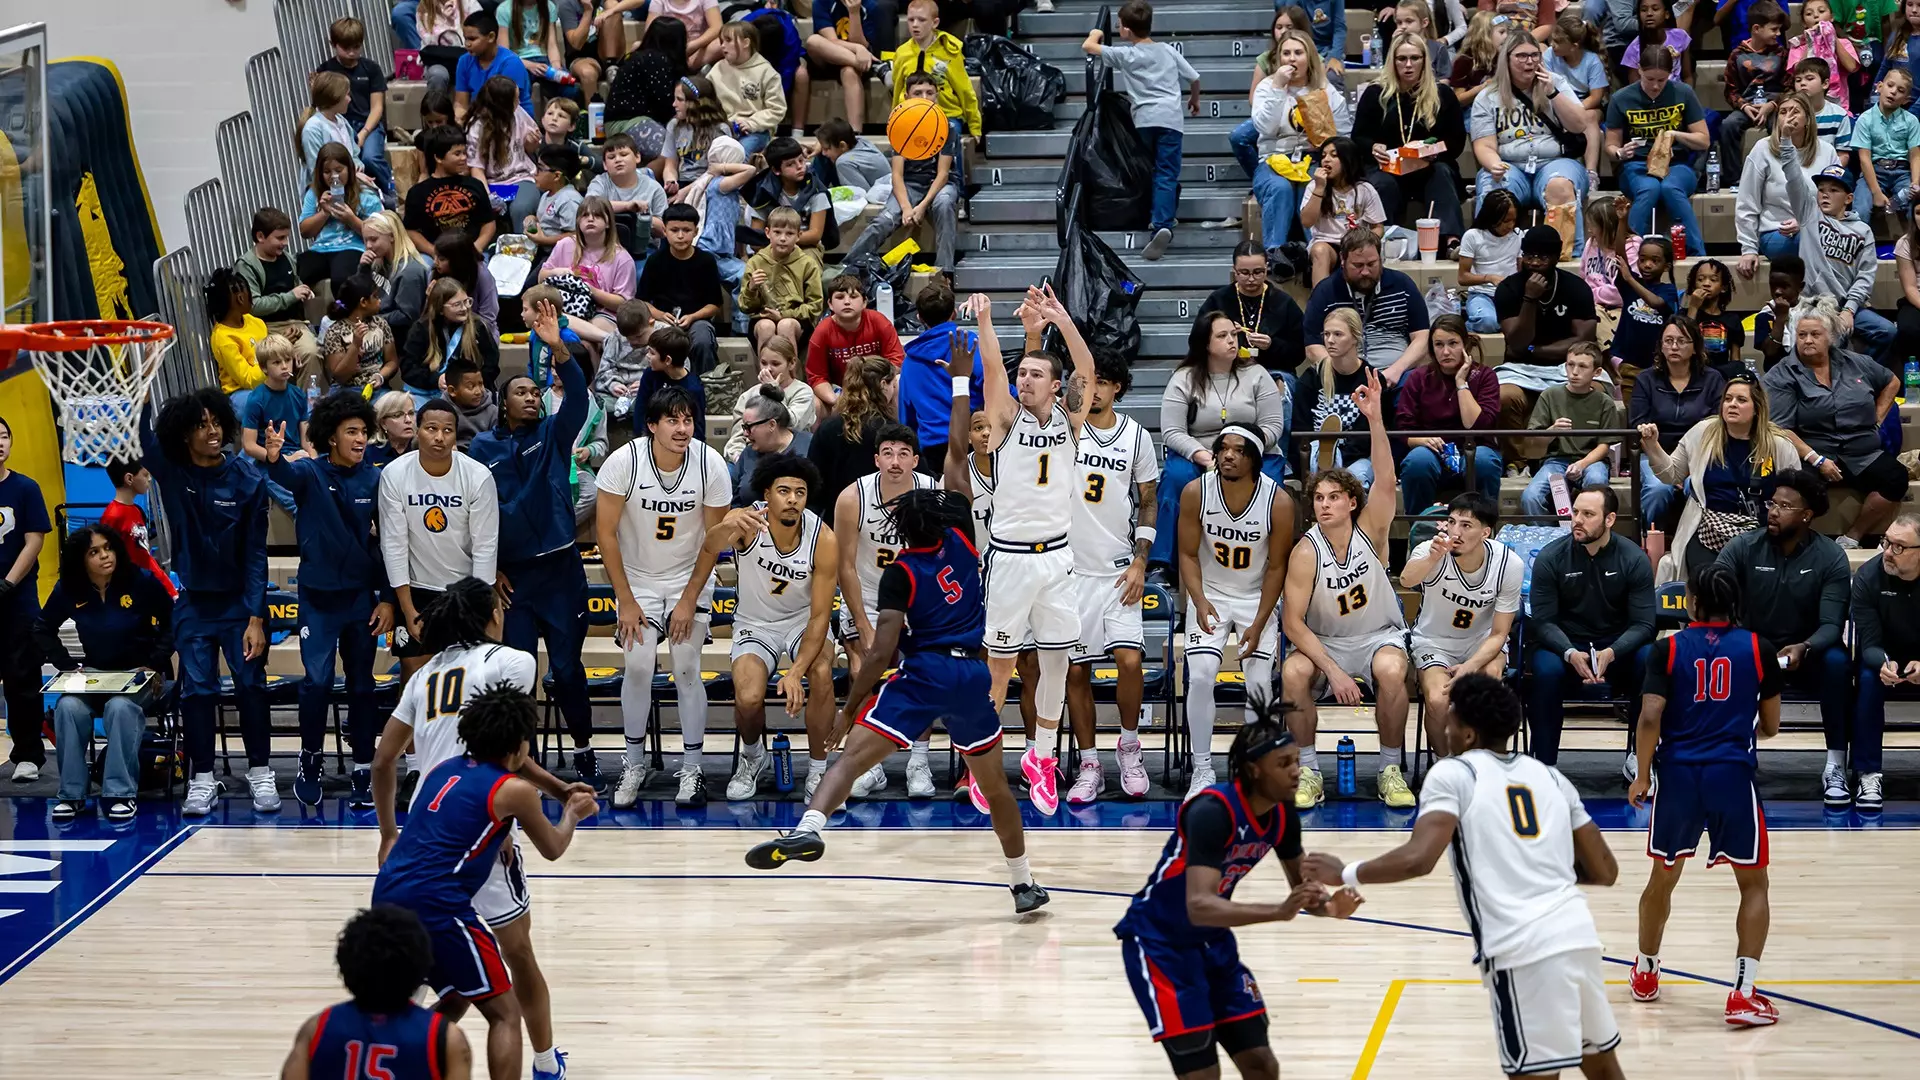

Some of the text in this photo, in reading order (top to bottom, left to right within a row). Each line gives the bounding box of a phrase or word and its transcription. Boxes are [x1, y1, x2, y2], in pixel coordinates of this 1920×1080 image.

[1235, 42, 1241, 56] B
[1211, 102, 1218, 117] B
[993, 169, 1001, 184] A
[1207, 165, 1214, 181] B
[981, 235, 988, 251] A
[1126, 233, 1133, 249] 7
[1819, 223, 1849, 252] REGION
[1179, 301, 1187, 317] B
[1019, 431, 1067, 448] LIONS
[1037, 452, 1051, 486] 1
[1075, 452, 1127, 472] LIONS
[1084, 472, 1107, 504] 3
[408, 493, 463, 507] LIONS
[641, 498, 696, 513] LIONS
[655, 515, 677, 541] 5
[1206, 523, 1261, 542] LIONS
[1214, 541, 1252, 570] 30
[757, 556, 808, 580] LIONS
[1326, 560, 1369, 590] LIONS
[770, 577, 790, 595] 7
[936, 565, 963, 605] 5
[1336, 583, 1369, 617] 13
[1441, 587, 1494, 608] LIONS
[1452, 609, 1475, 630] 8
[996, 631, 1011, 645] ET
[1189, 633, 1202, 644] ET
[1694, 656, 1732, 703] 10
[426, 666, 466, 722] 10
[427, 775, 462, 812] 1
[1505, 784, 1541, 839] 0
[344, 1039, 398, 1080] 15
